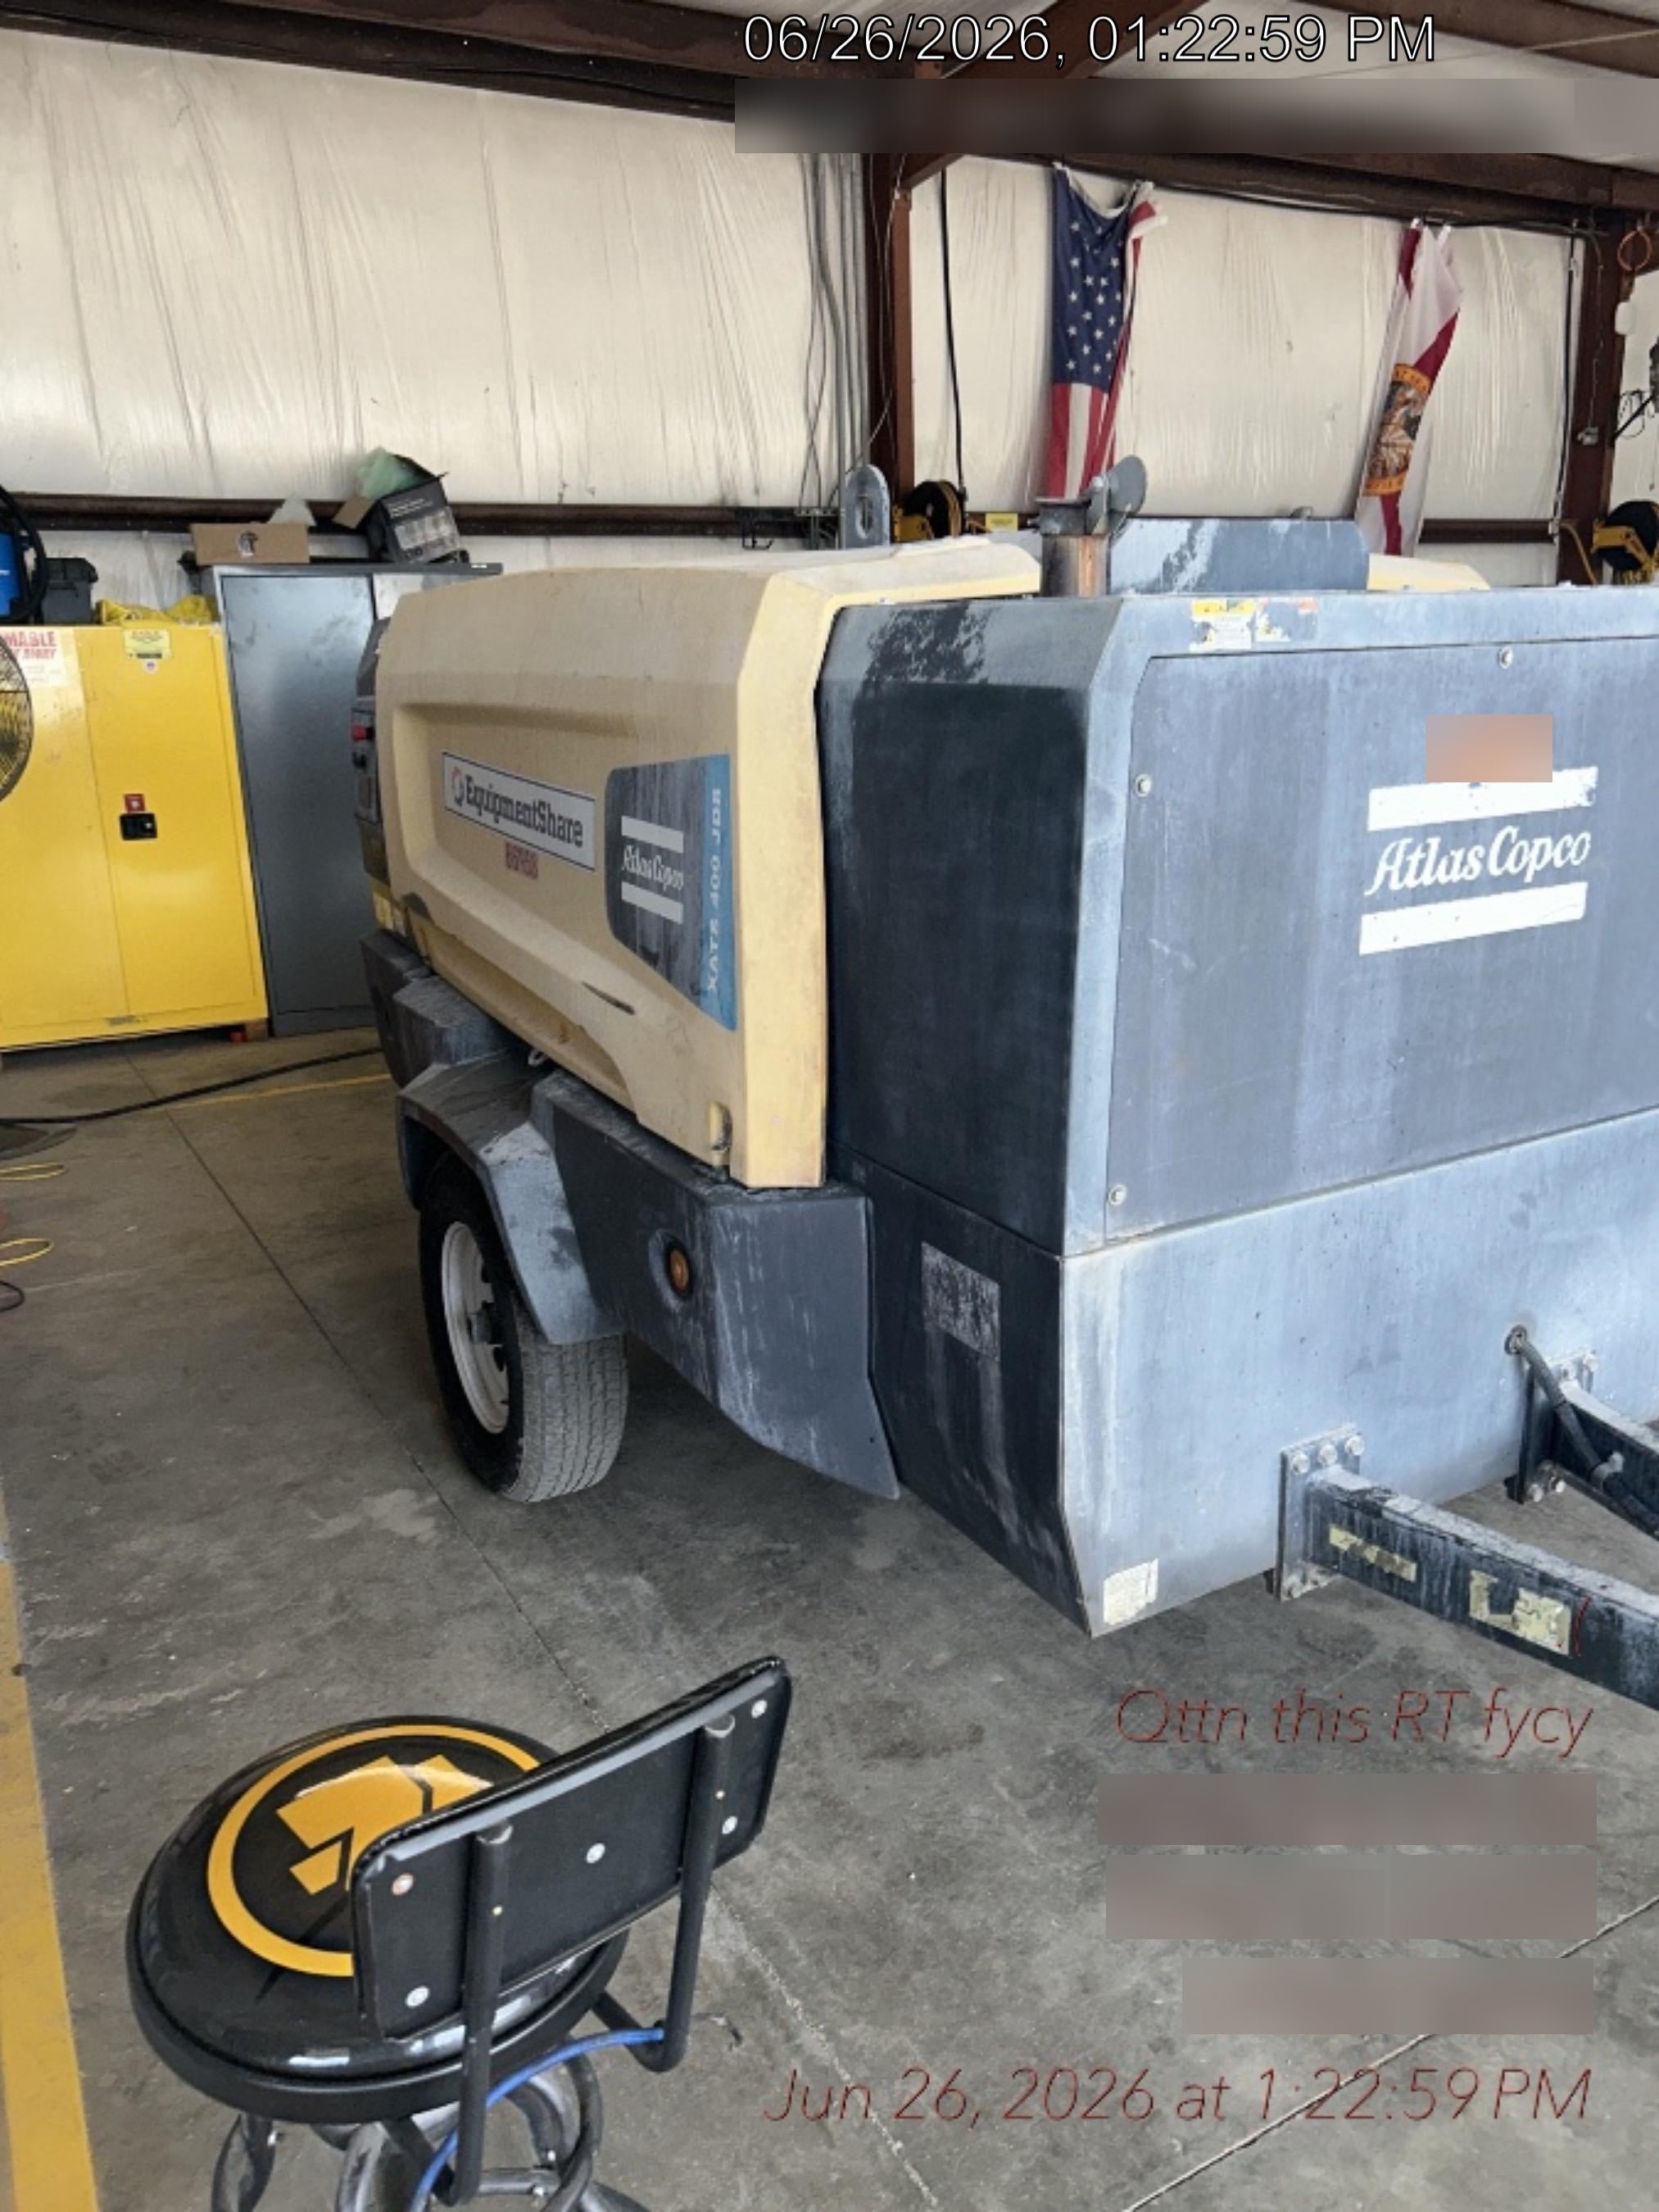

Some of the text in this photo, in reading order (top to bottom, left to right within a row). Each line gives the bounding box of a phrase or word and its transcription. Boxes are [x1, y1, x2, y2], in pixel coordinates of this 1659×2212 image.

[465, 773, 583, 849] EquipmentShare
[1363, 824, 1592, 897] Atlas Copco
